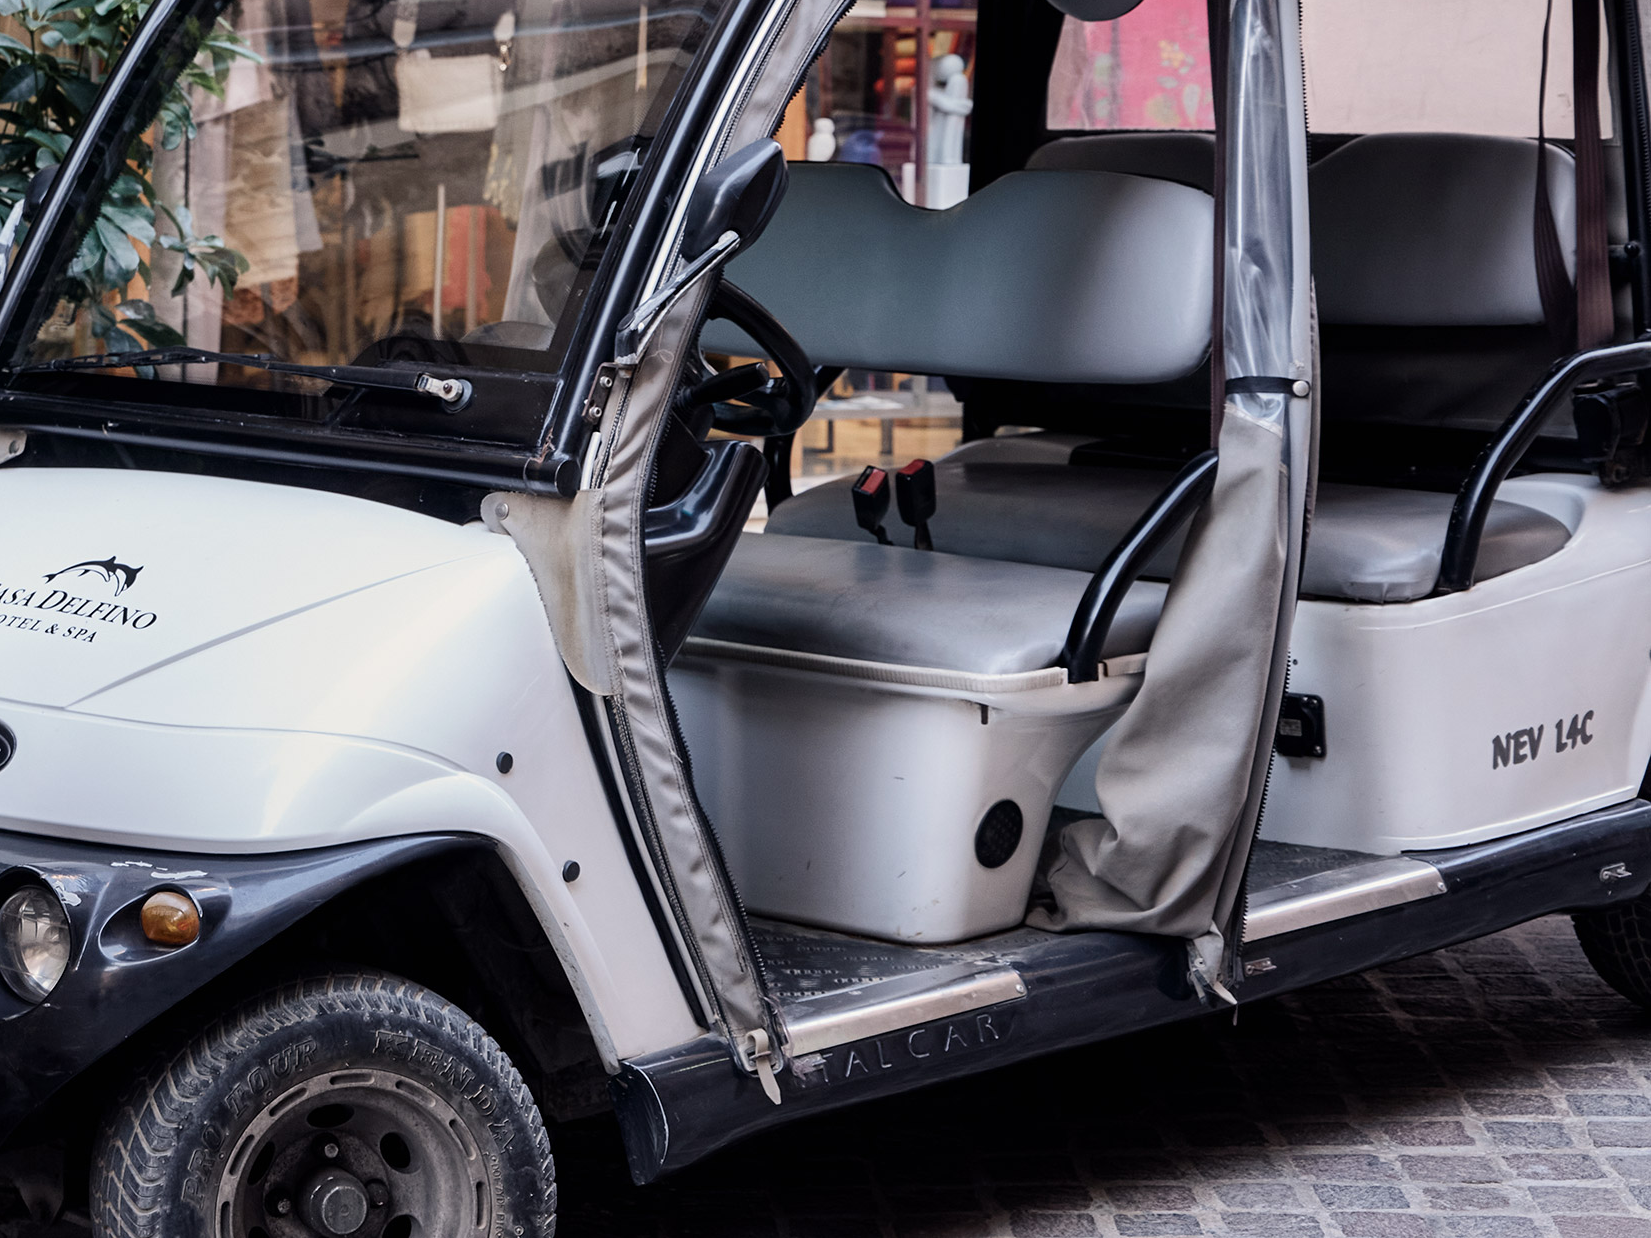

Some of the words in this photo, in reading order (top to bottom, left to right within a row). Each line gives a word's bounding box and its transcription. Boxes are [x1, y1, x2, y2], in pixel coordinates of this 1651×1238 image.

[34, 589, 158, 630] DELFINO
[44, 623, 59, 635] &
[61, 625, 99, 644] SPA
[1491, 724, 1545, 770] NEV
[801, 1013, 1000, 1088] TALCAR
[372, 1029, 516, 1155] KENDA
[181, 1123, 225, 1210] PRO
[224, 1037, 318, 1120] TOUR
